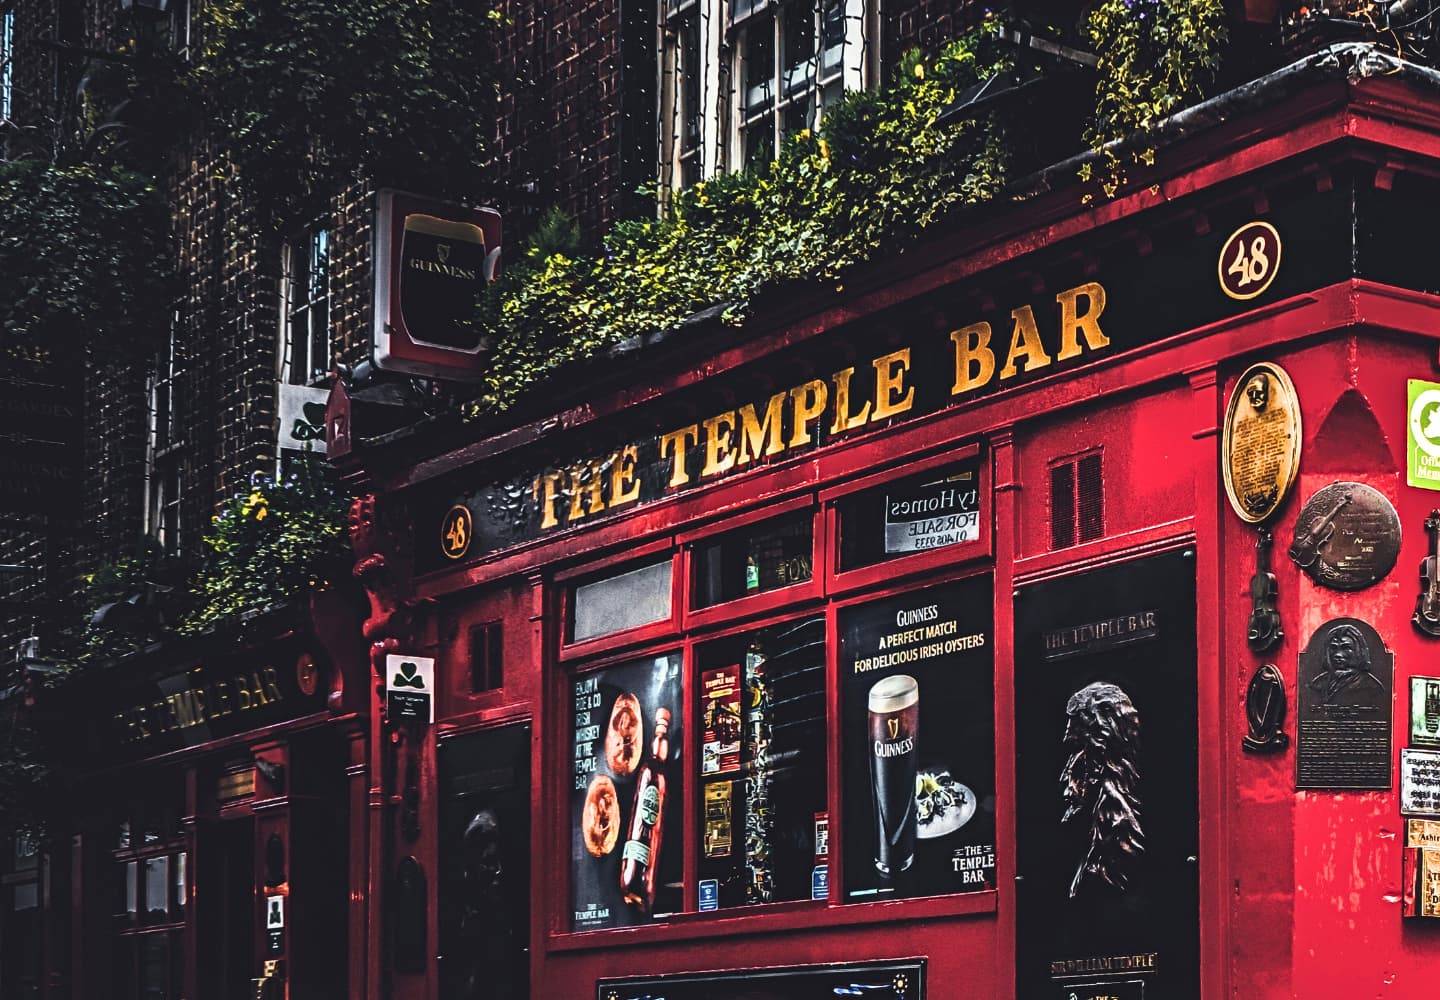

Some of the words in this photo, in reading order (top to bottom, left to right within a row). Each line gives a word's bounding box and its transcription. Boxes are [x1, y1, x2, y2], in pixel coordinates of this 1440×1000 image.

[410, 258, 476, 281] GUINNESS
[1228, 236, 1269, 287] 48
[533, 444, 641, 529] THE
[661, 347, 914, 487] TEMPLE
[950, 282, 1110, 395] BAR
[448, 517, 466, 552] 48
[897, 605, 938, 627] GUINNESS
[879, 637, 887, 650] A
[887, 629, 925, 647] PERFECT
[926, 621, 957, 639] MATCH
[1045, 632, 1069, 649] THE
[1072, 618, 1124, 644] TEMPLE
[1128, 612, 1156, 632] BAR
[854, 659, 872, 674] FOR
[872, 647, 918, 670] DELICIOUS
[919, 642, 943, 660] IRISH
[945, 634, 985, 655] OYSTERS
[235, 666, 283, 711] BAR
[874, 737, 913, 758] GUINNESS
[576, 757, 597, 773] TEMPLE
[952, 854, 995, 872] TEMPLE
[964, 845, 983, 857] THE
[963, 870, 985, 884] BAR
